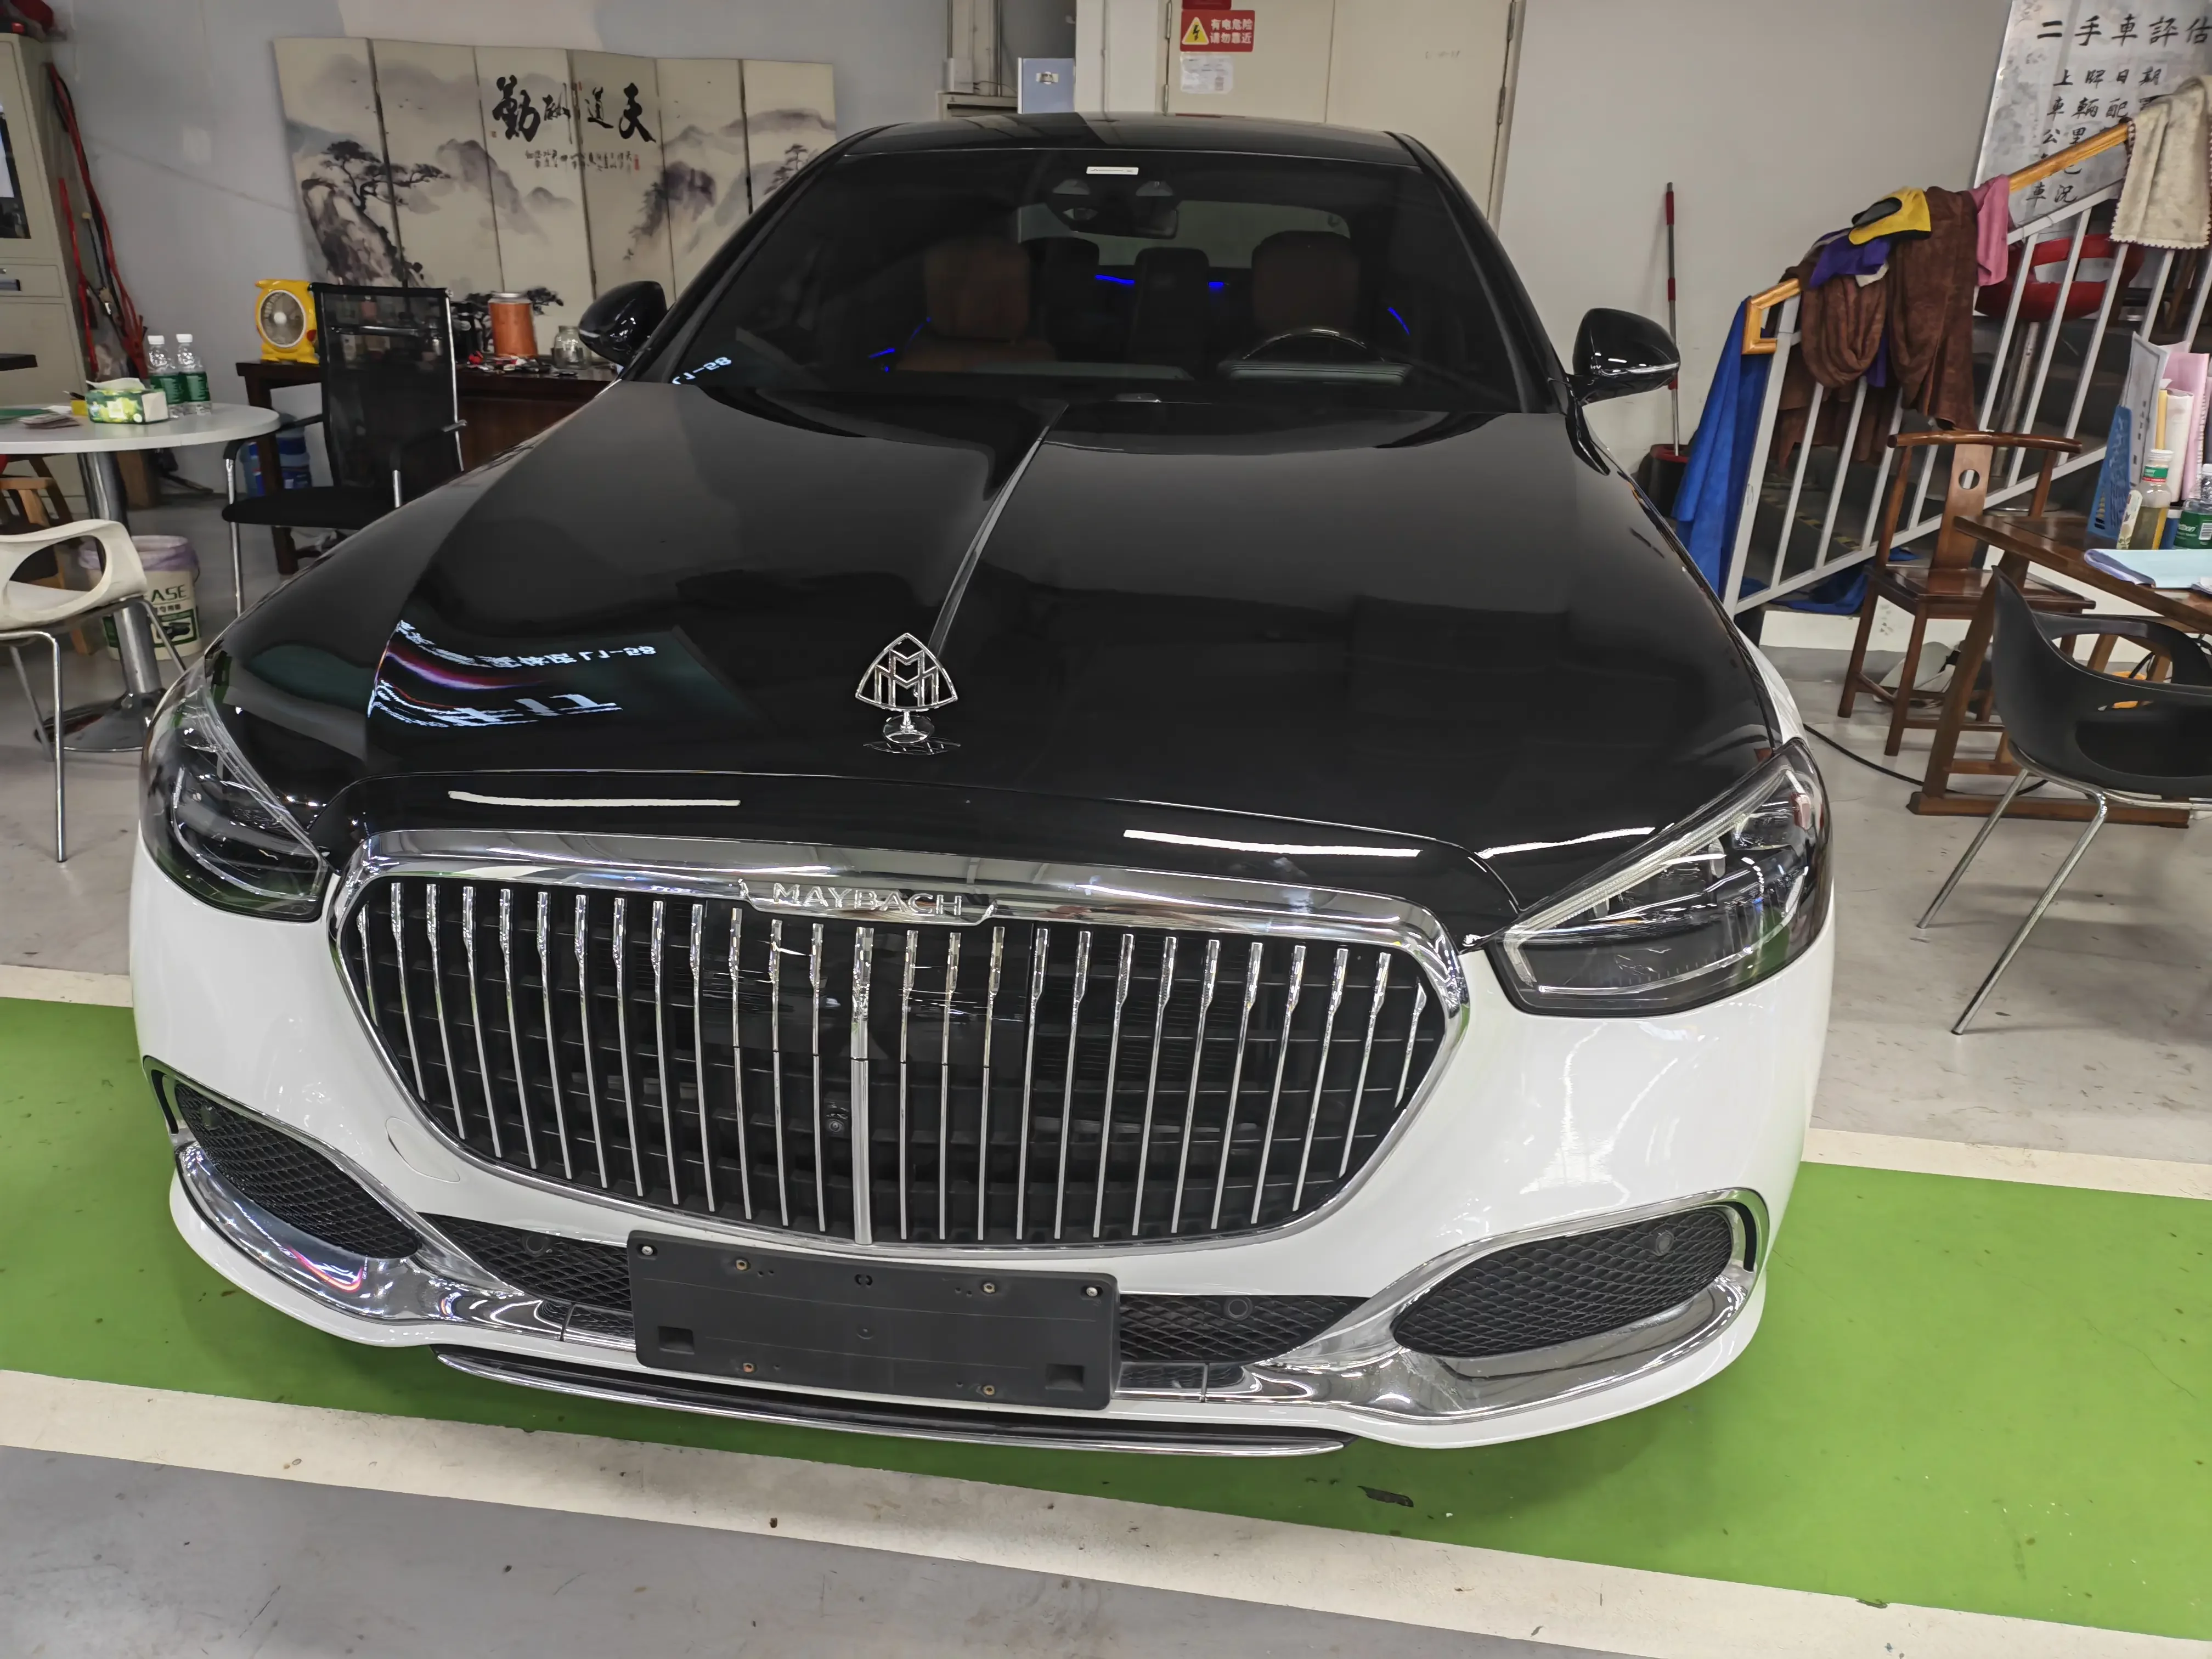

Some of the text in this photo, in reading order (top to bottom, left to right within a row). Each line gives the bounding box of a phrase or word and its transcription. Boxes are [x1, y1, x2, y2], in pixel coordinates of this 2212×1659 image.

[1211, 18, 1254, 31] 有电危险
[2037, 14, 2212, 47] 二手車評估
[1210, 32, 1252, 44] 请勿靠近
[151, 584, 187, 602] ASE
[773, 882, 962, 916] MAYBACH
